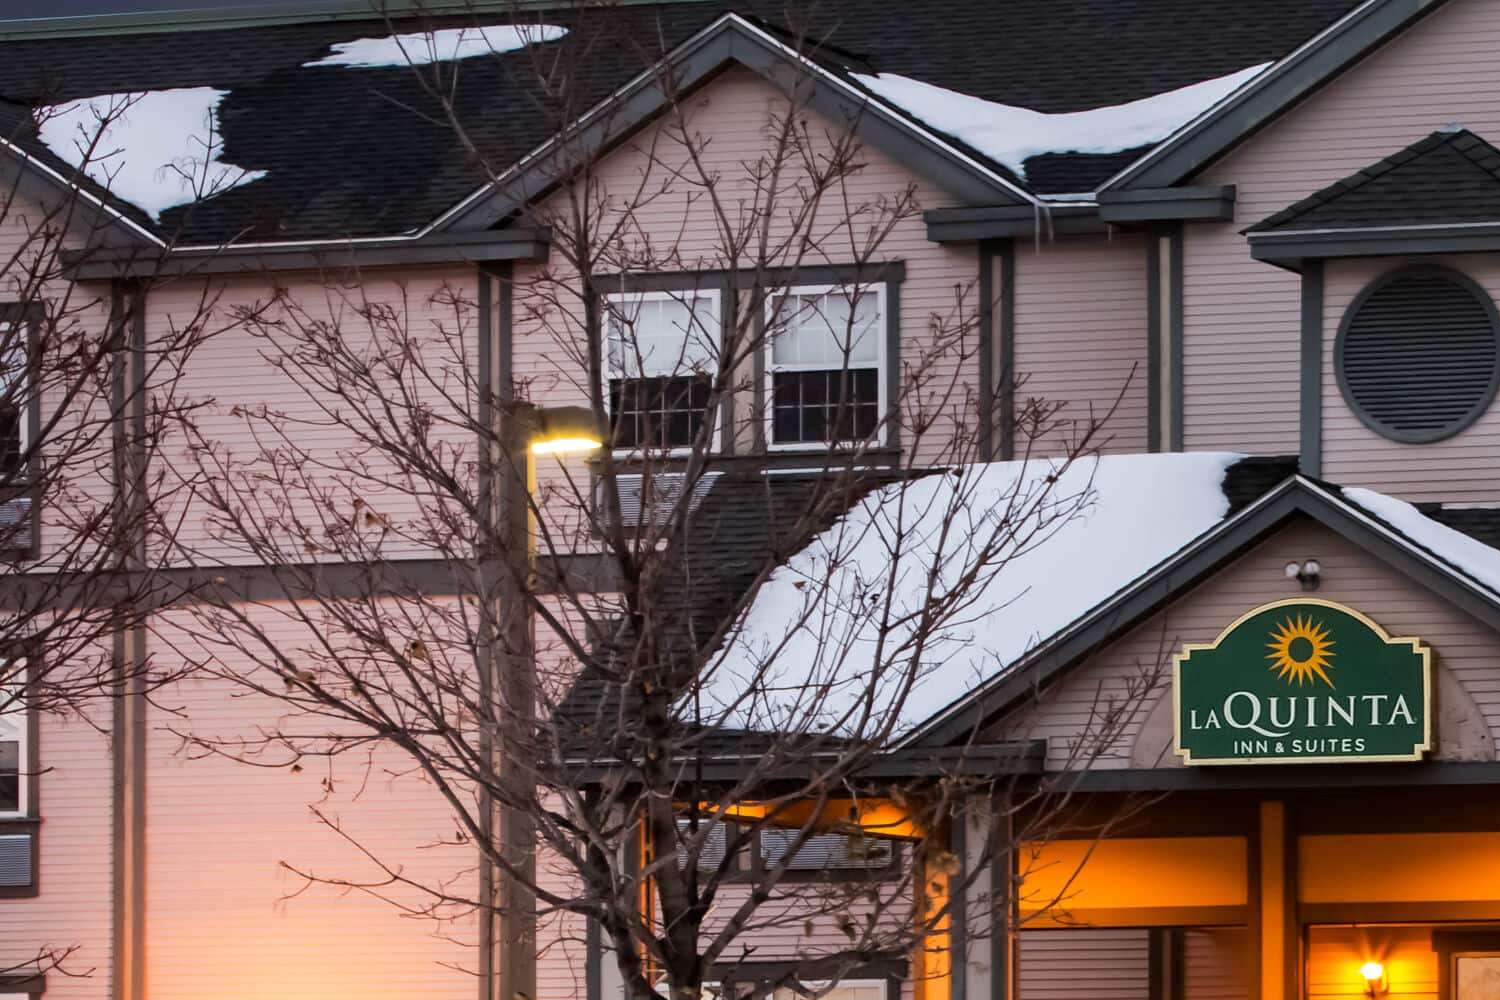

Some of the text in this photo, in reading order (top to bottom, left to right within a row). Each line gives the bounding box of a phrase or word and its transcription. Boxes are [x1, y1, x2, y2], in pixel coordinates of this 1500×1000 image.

[1191, 691, 1416, 737] LA QUINTA
[1234, 738, 1365, 754] INN & SUITES
